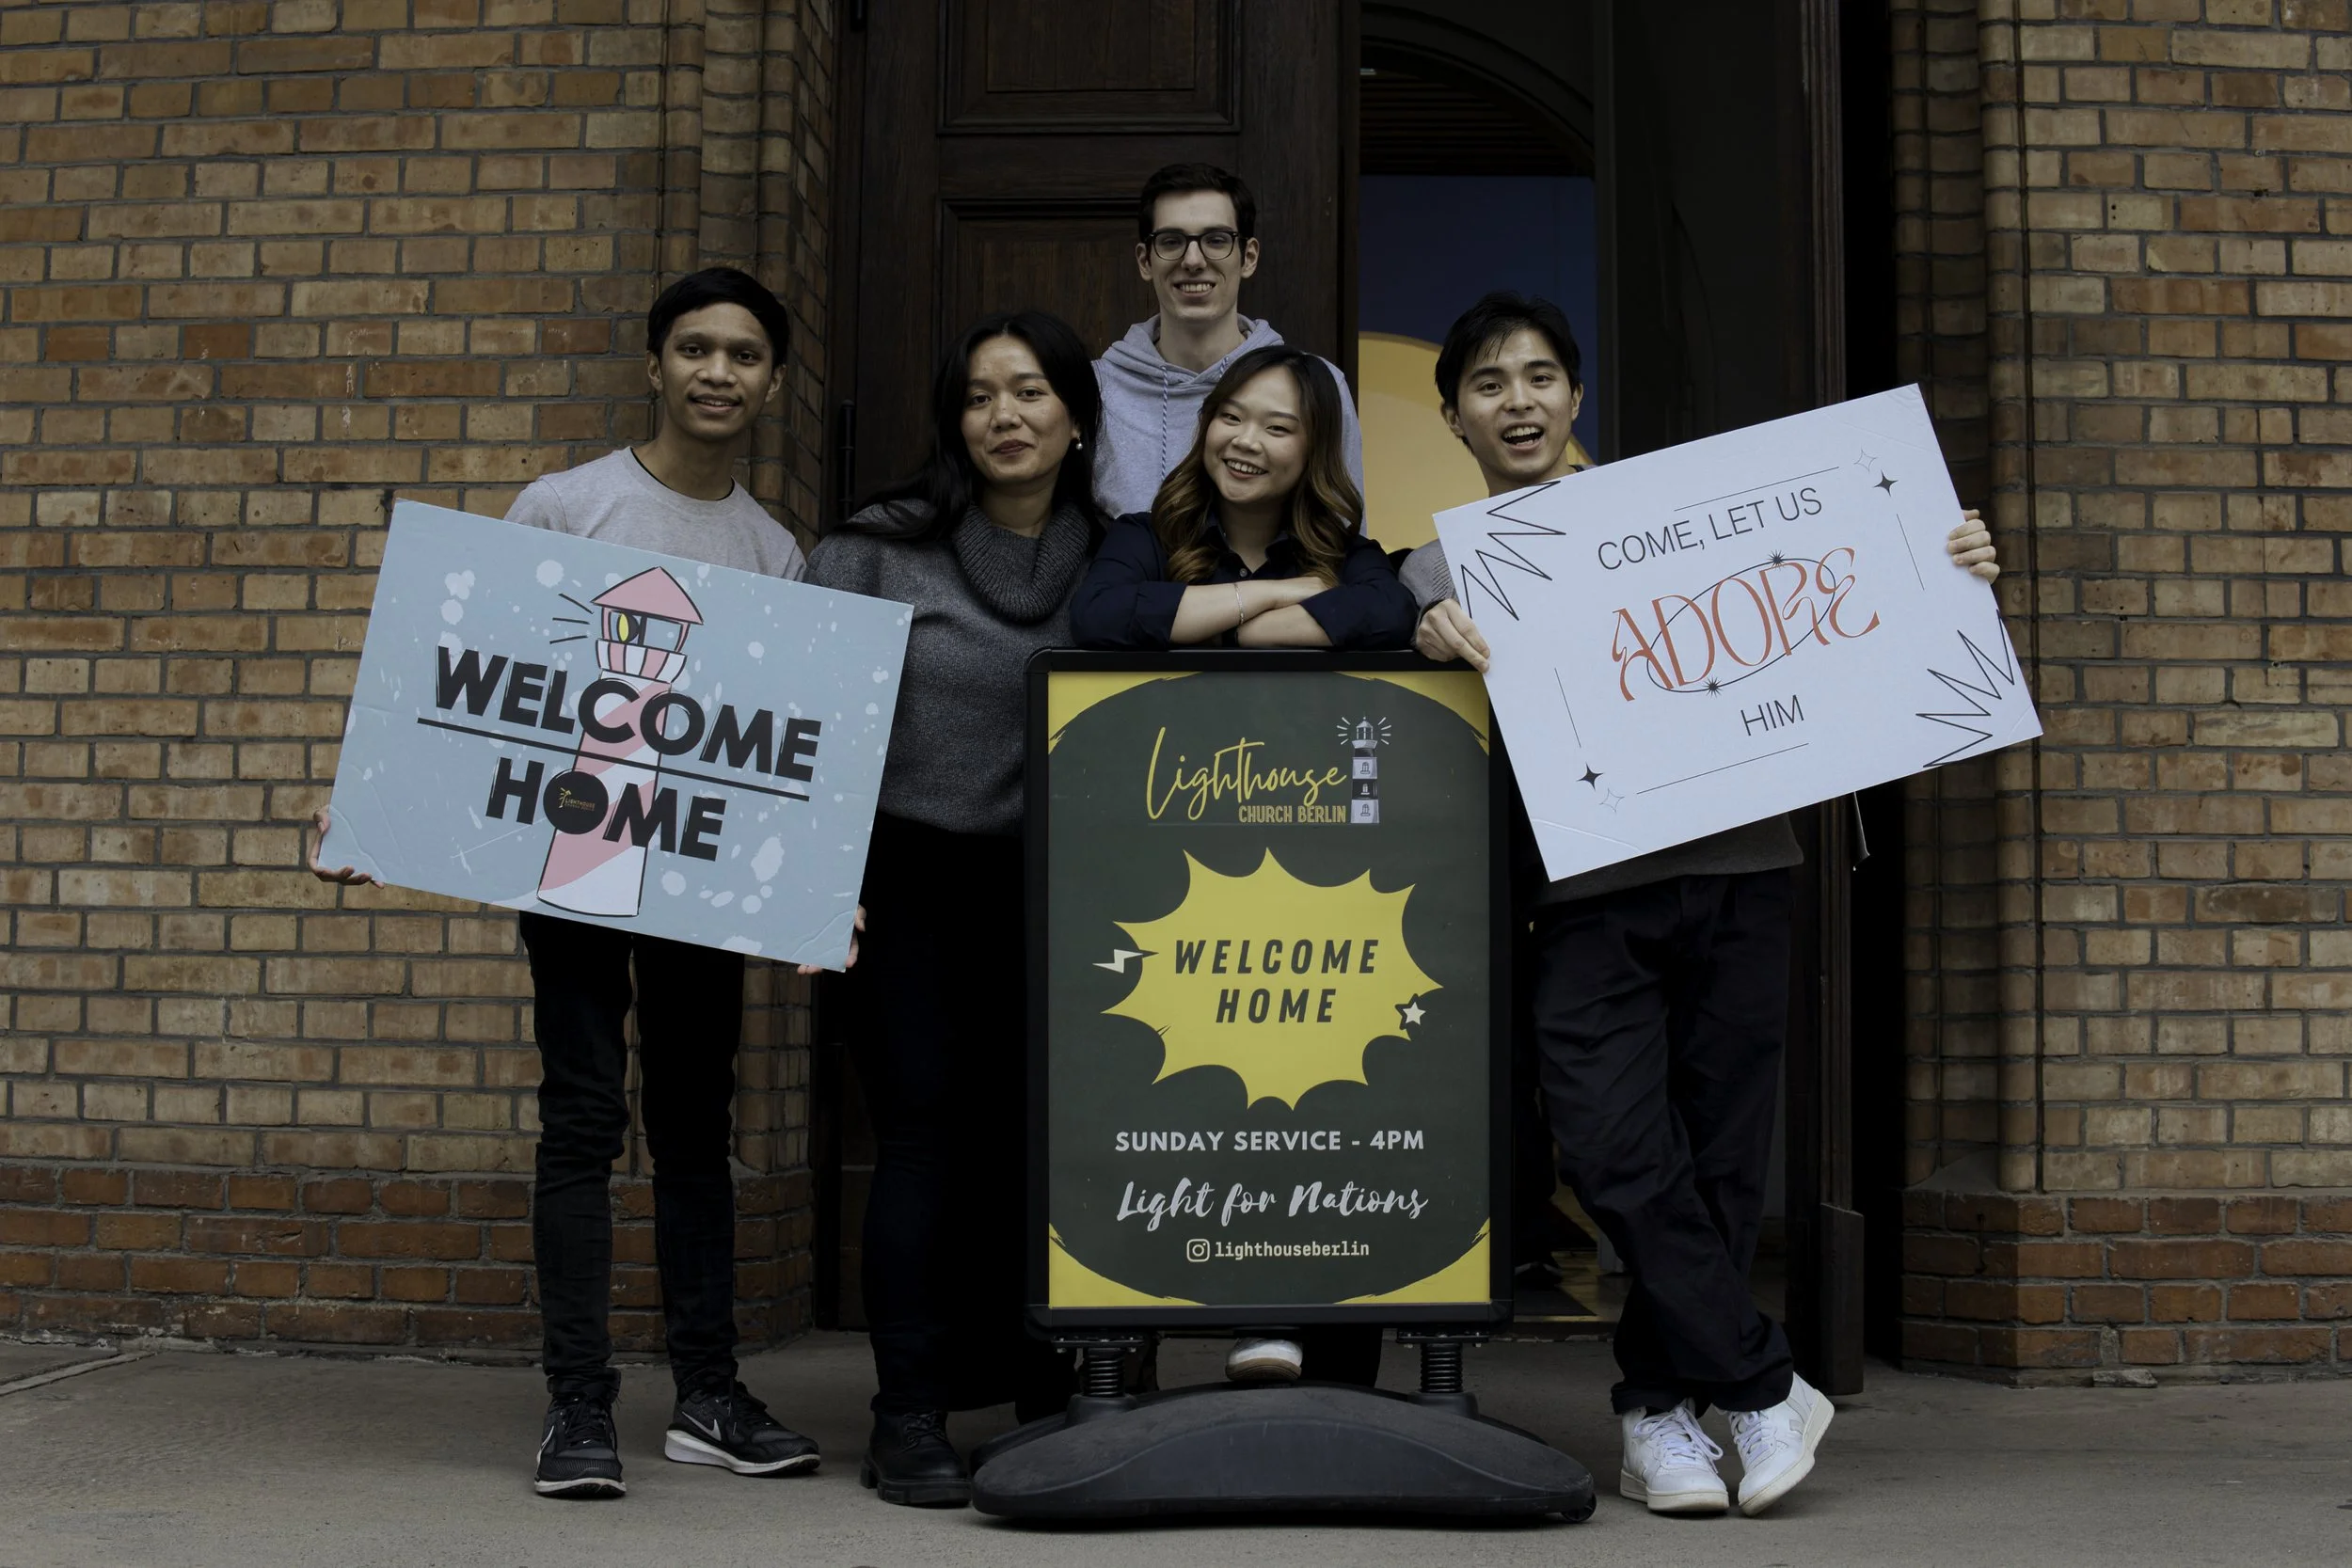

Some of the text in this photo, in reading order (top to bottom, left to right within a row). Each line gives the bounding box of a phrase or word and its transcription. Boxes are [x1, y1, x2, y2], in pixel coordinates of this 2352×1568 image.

[1597, 487, 1823, 570] COME, LET US
[1610, 546, 1881, 702] ADORE
[436, 644, 822, 784] WELCOME
[1740, 693, 1805, 737] HIM
[1146, 726, 1347, 821] Lighthouse
[485, 756, 727, 862] HOME
[1238, 804, 1347, 822] CHURCH BERLIN
[1174, 938, 1379, 975] WELCOME
[1215, 988, 1337, 1024] HOME
[1114, 1131, 1225, 1153] SUNDAY
[1233, 1130, 1342, 1152] SERVICE
[1369, 1129, 1425, 1151] 4PM
[1116, 1176, 1430, 1232] Light for Nations
[1214, 1240, 1370, 1261] lighthouseberlin
